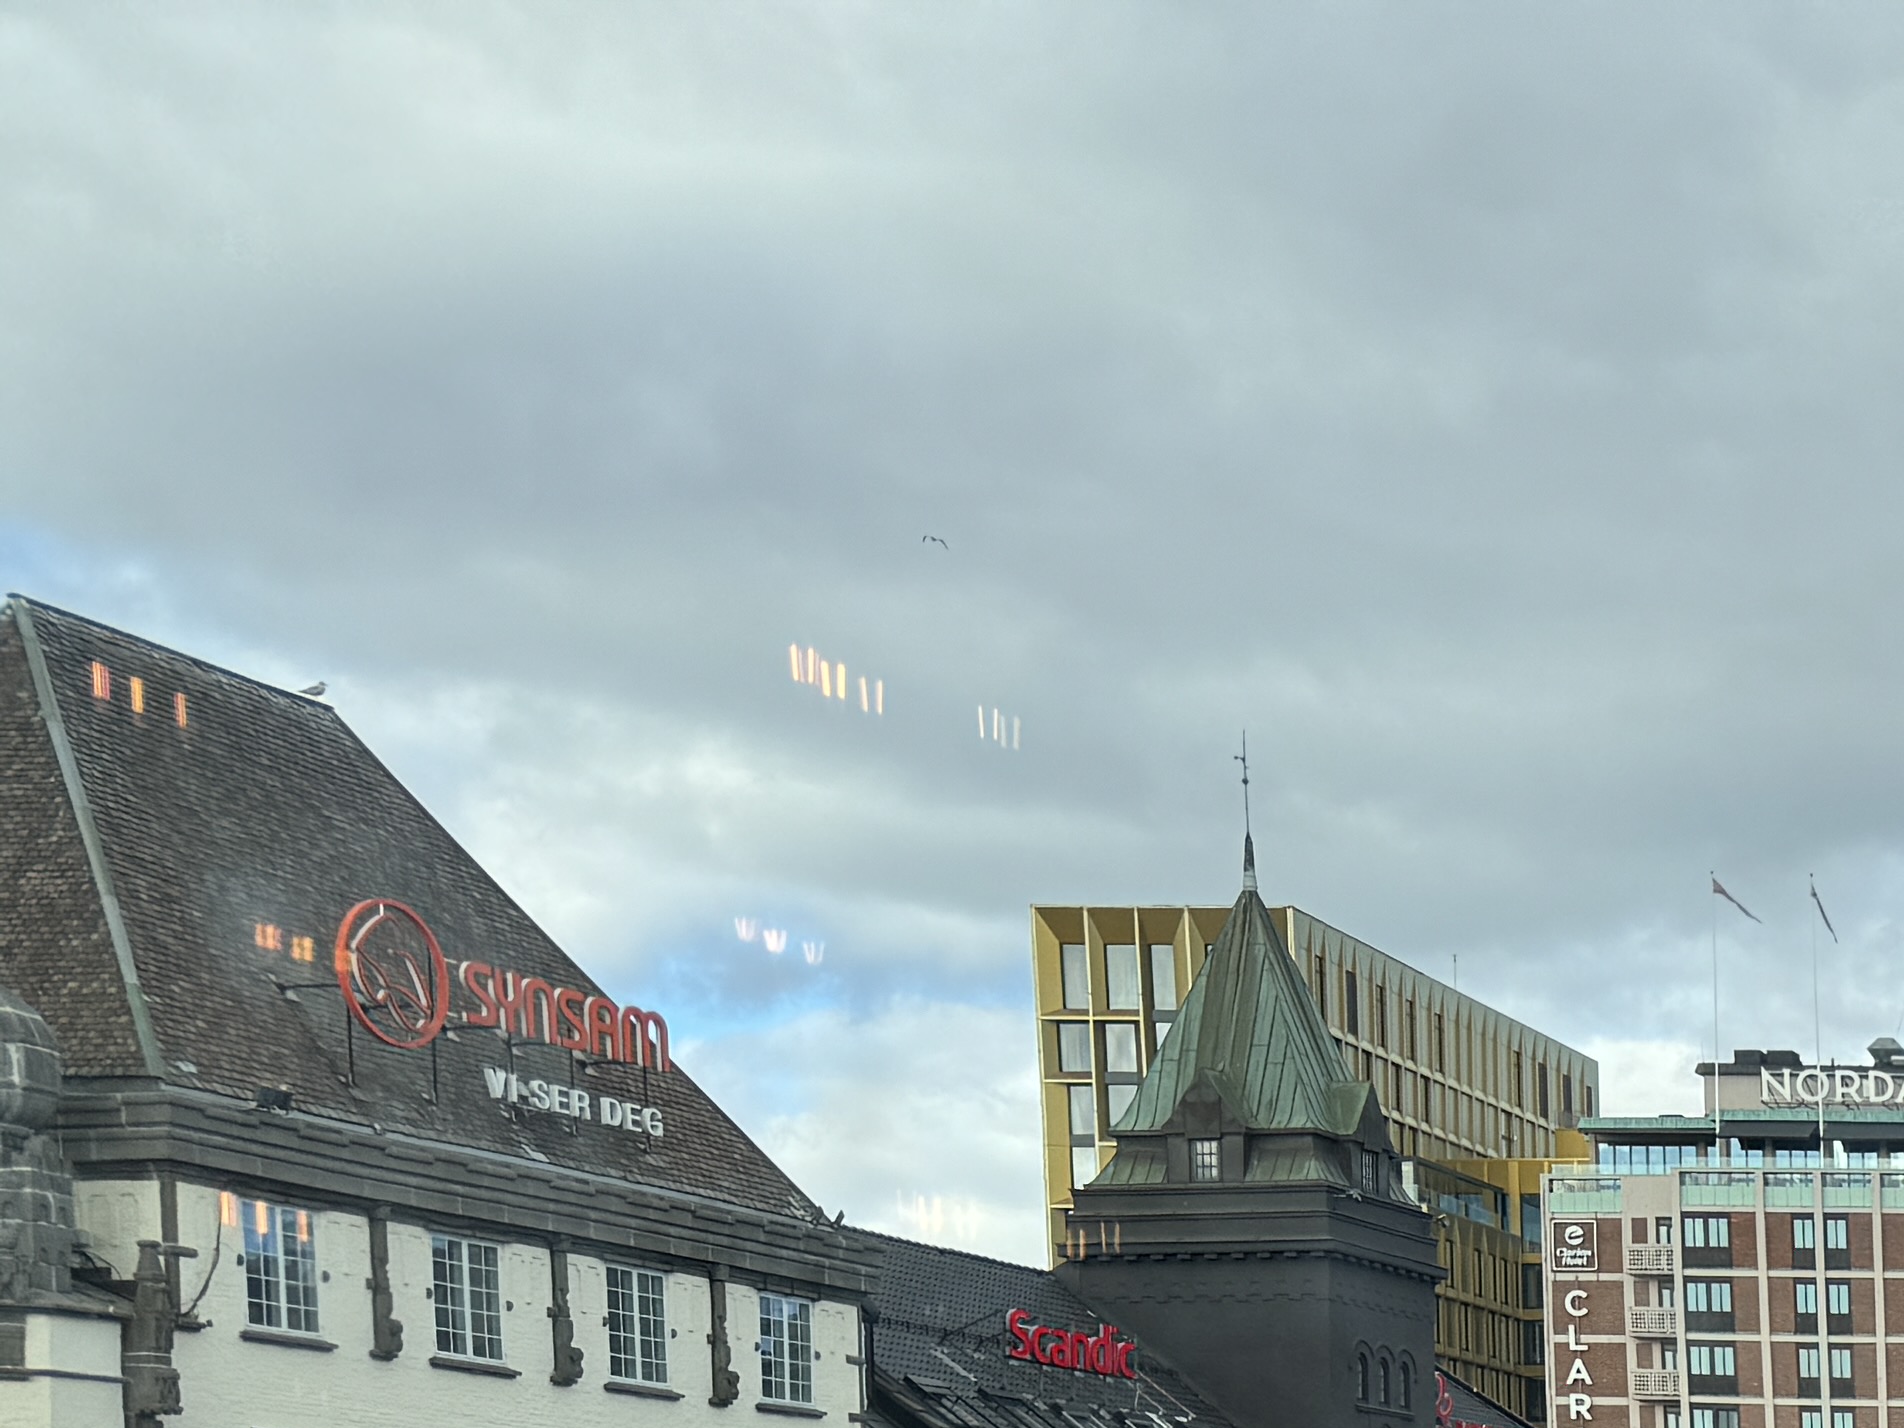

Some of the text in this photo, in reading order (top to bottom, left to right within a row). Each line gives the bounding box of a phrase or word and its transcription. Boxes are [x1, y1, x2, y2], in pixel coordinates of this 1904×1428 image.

[460, 961, 671, 1072] SYNSAM
[484, 1066, 664, 1137] VI SER DEG
[1006, 1308, 1137, 1379] Scandic
